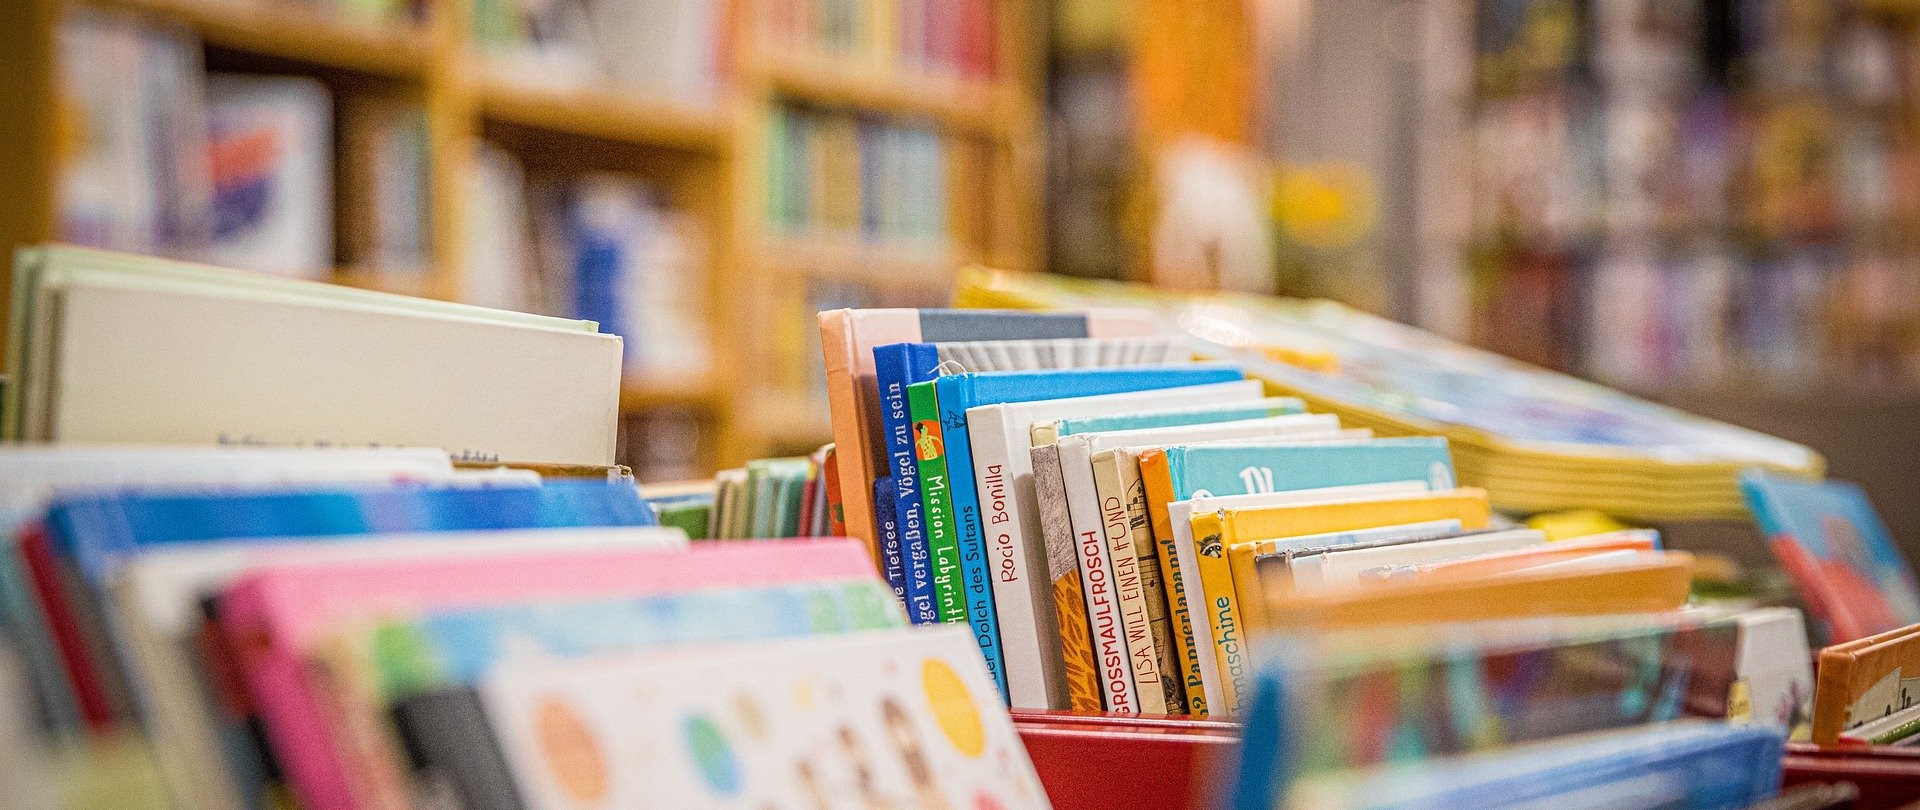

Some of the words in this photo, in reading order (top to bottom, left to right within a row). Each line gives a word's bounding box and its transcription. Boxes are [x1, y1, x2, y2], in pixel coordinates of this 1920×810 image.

[886, 381, 905, 419] sein
[894, 424, 909, 445] zu
[894, 450, 916, 499] Vögel
[985, 464, 1009, 524] Bonilla
[927, 475, 945, 539] Mission
[1104, 496, 1130, 551] HUND
[885, 520, 902, 581] Tiefsee
[905, 502, 927, 589] vergaßen,
[963, 505, 980, 561] Sultans
[996, 533, 1018, 582] Rocio
[935, 546, 964, 625] Labyrinth
[970, 567, 984, 593] des
[1116, 556, 1140, 602] EINEN
[973, 600, 992, 648] Dolch
[1126, 605, 1146, 644] WILL
[1134, 645, 1159, 684] LISA
